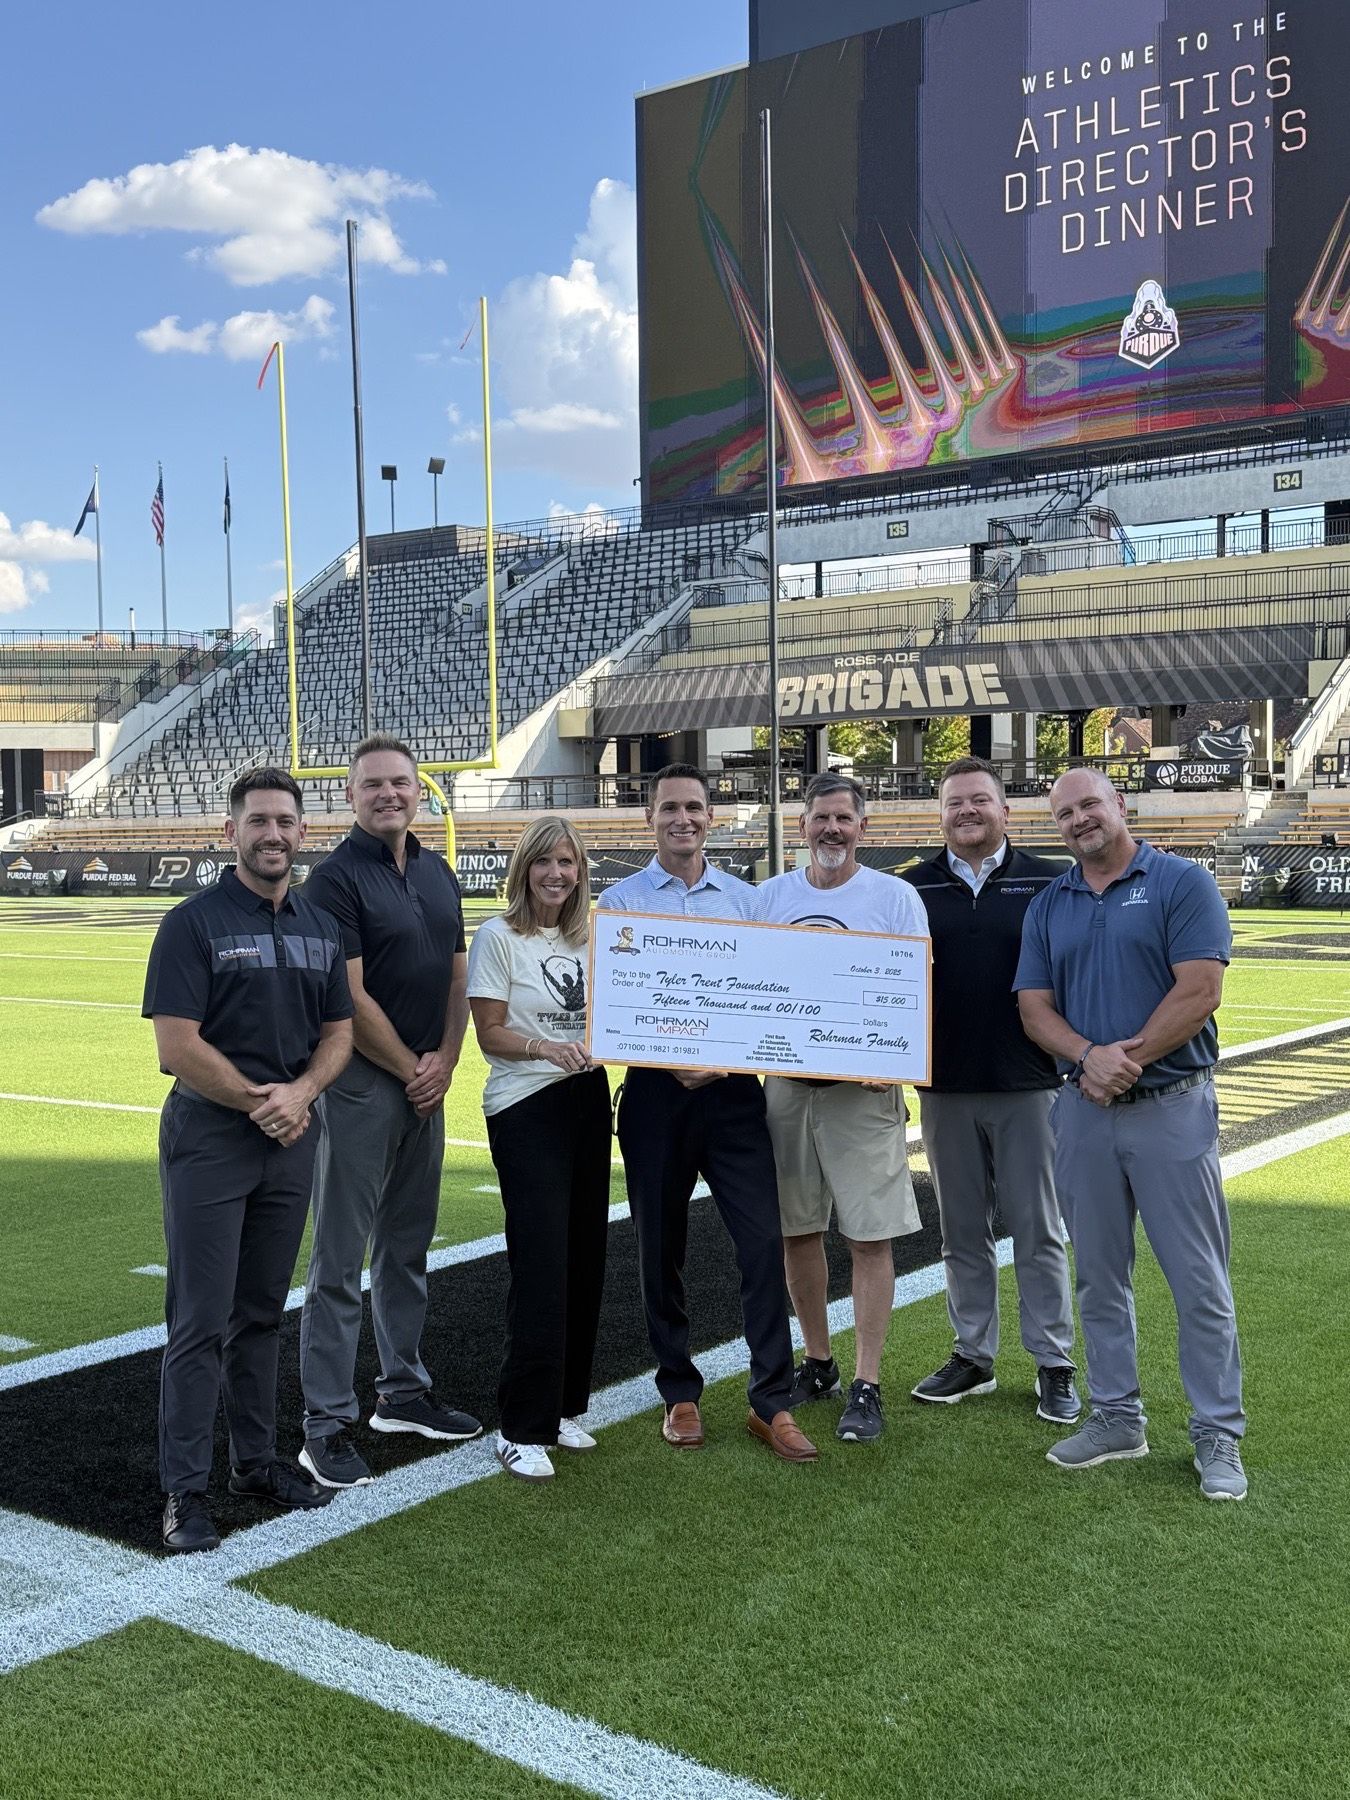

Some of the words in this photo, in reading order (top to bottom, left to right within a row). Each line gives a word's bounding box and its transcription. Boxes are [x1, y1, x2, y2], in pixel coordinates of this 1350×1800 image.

[1022, 45, 1154, 94] WELCOME
[1177, 32, 1208, 55] TO
[1233, 12, 1287, 41] THE
[1014, 55, 1292, 158] ATHLETICS
[1005, 108, 1307, 213] DIRECTOR'S
[1062, 176, 1253, 254] DINNER
[1125, 332, 1174, 357] PURDUE
[1276, 472, 1300, 490] 134
[889, 522, 907, 537] 135
[834, 652, 921, 668] ROSS-ADE
[777, 663, 1010, 717] BRIGADE
[1181, 763, 1230, 775] PURDUE
[1322, 756, 1338, 772] 31
[718, 779, 733, 793] 33
[785, 776, 799, 790] 32
[1180, 774, 1222, 784] GLOBAL
[7, 871, 32, 880] PURDUE
[82, 873, 108, 881] PURDUE
[109, 873, 137, 882] FEDERAL
[643, 934, 737, 953] ROHRMAN
[218, 946, 260, 960] ROHRMAN
[646, 947, 702, 958] AUTOMOTIVE
[706, 951, 737, 960] GROUP
[890, 950, 914, 959] 10706
[612, 968, 627, 979] Pay
[638, 971, 651, 979] the
[850, 964, 873, 974] October
[884, 967, 902, 976] 2025
[611, 978, 635, 987] Order
[636, 980, 644, 988] of
[656, 970, 686, 988] Tyler
[691, 973, 723, 988] Trent
[726, 976, 790, 993] Foundation
[651, 993, 690, 1008] Fifteen
[695, 995, 748, 1010] Thousand
[751, 1002, 772, 1012] and
[775, 1002, 821, 1015] 00/100
[537, 1012, 571, 1022] TYLER
[635, 1014, 709, 1028] ROHRMAN
[863, 1018, 888, 1028] Dollars
[656, 1025, 708, 1037] IMPACT
[809, 1028, 863, 1044] Rohrman
[867, 1033, 909, 1052] Family
